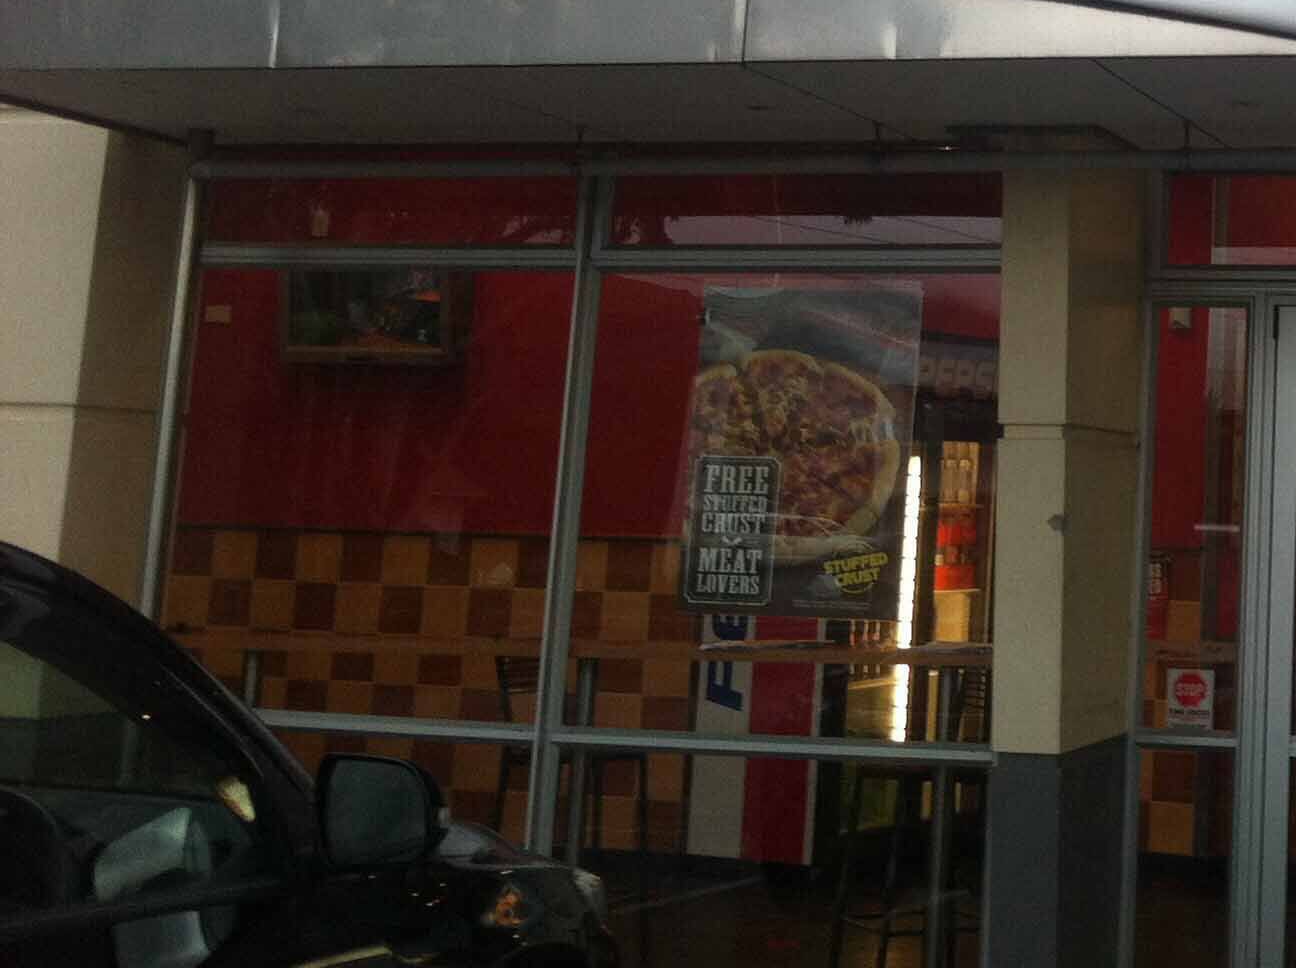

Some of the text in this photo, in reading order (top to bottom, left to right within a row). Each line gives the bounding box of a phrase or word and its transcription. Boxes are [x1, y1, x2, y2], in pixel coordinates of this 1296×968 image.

[703, 464, 770, 494] FREE
[702, 495, 768, 513] STUFFED
[701, 512, 767, 534] CRUST
[697, 547, 763, 574] MEAT
[823, 552, 889, 576] STUFFED
[695, 574, 761, 594] LOVERS
[835, 567, 881, 586] CRUST
